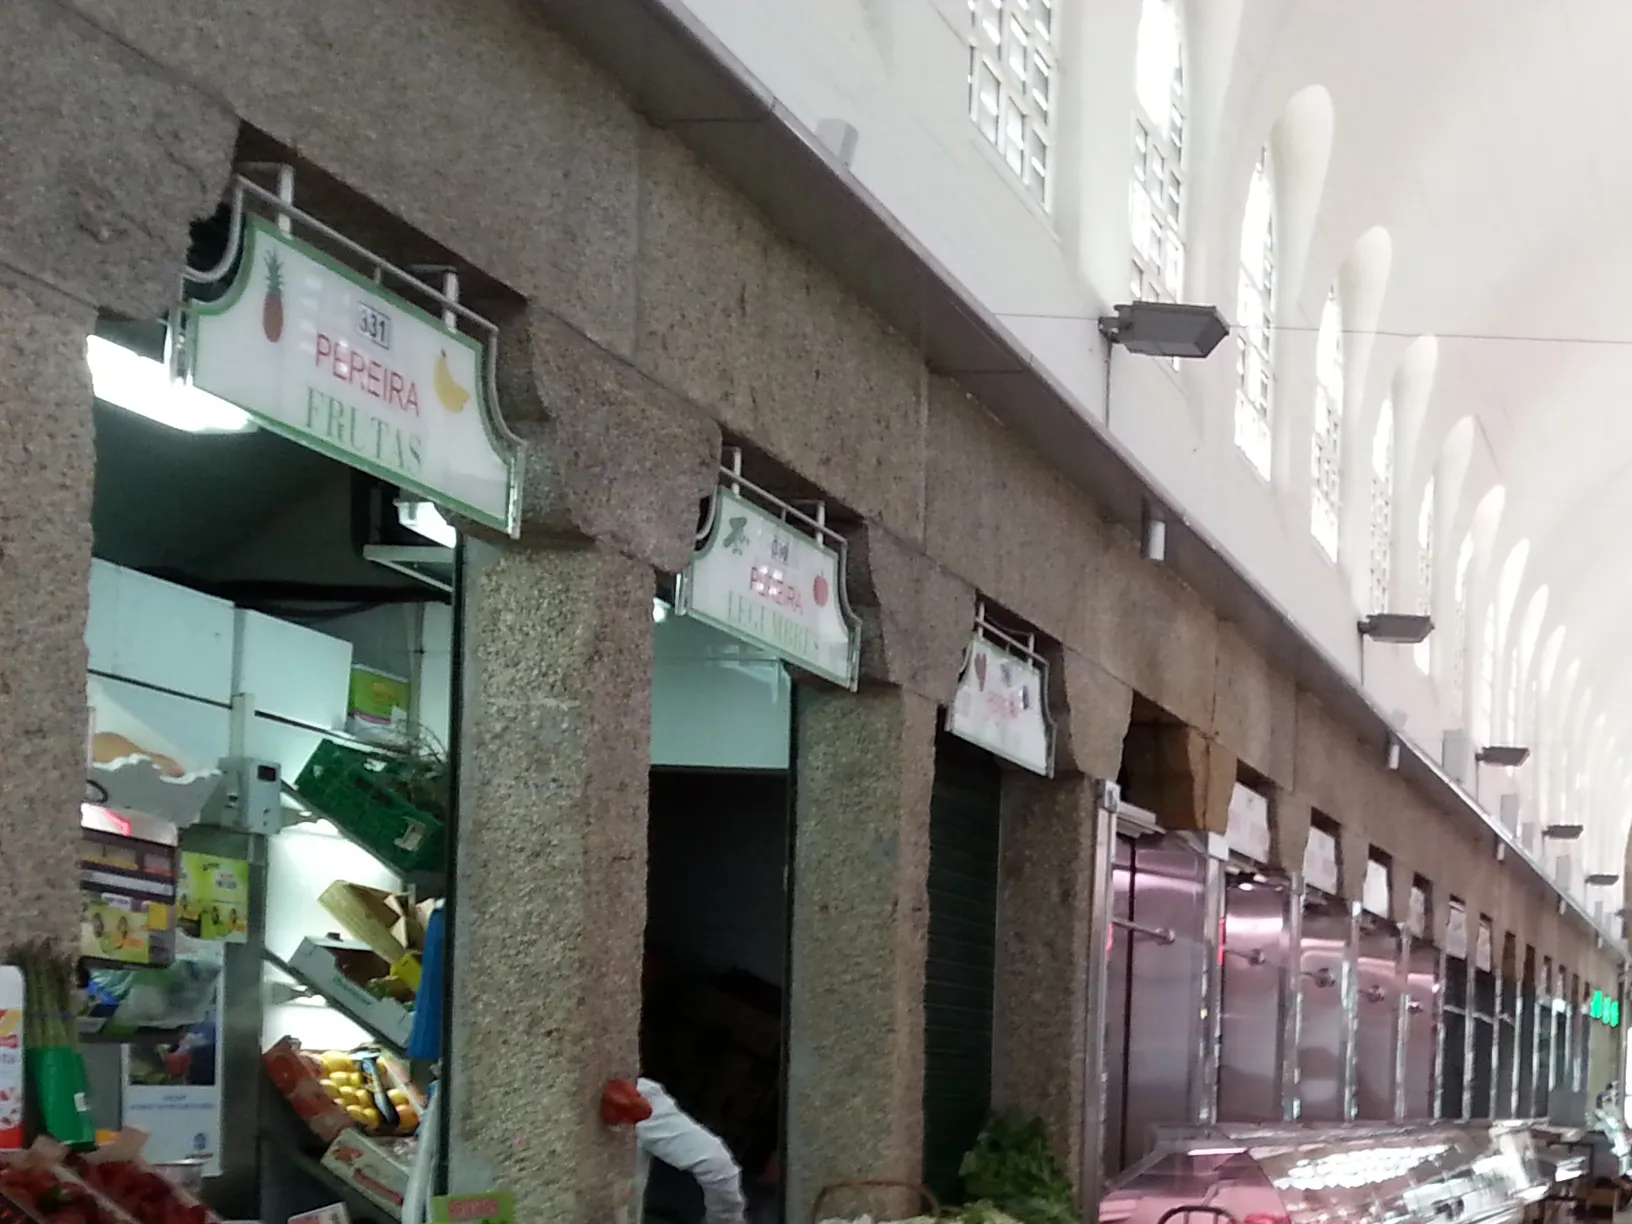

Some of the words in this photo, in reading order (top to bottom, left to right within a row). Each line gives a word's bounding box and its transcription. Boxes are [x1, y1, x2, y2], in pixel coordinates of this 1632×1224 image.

[358, 306, 386, 344] 331
[315, 332, 420, 418] PEREIRA
[305, 386, 423, 476] FRUTAS
